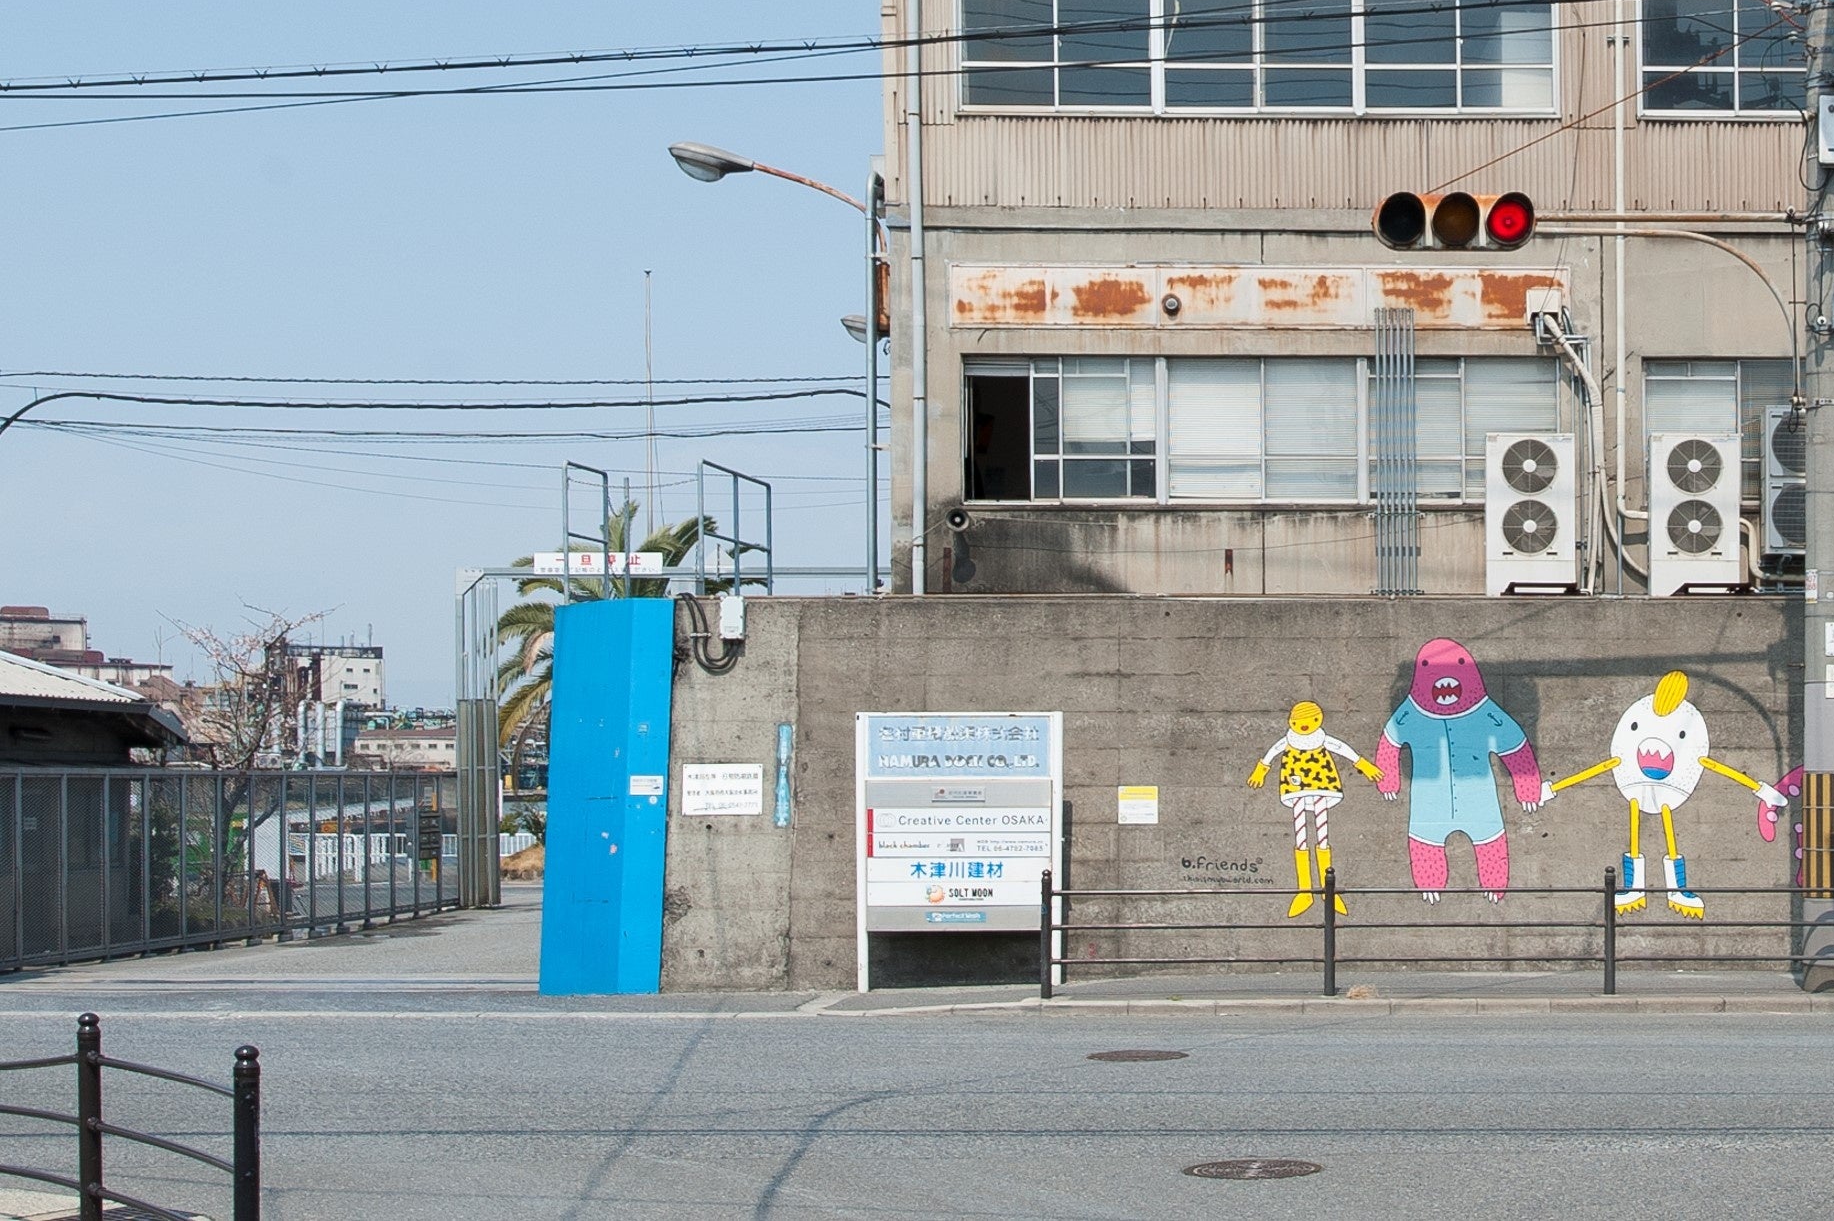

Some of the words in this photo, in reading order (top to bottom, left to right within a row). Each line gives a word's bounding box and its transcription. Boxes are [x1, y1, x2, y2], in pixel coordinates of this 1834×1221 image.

[878, 755, 940, 768] NAMURA
[945, 755, 984, 768] DOCK
[898, 815, 951, 826] Creative
[955, 815, 997, 826] Center
[1001, 815, 1044, 825] OSAKA
[878, 840, 897, 849] black
[900, 840, 930, 849] chamber
[910, 861, 1004, 878] 木津川建材
[949, 888, 968, 898] SOLT
[972, 888, 993, 898] MOON
